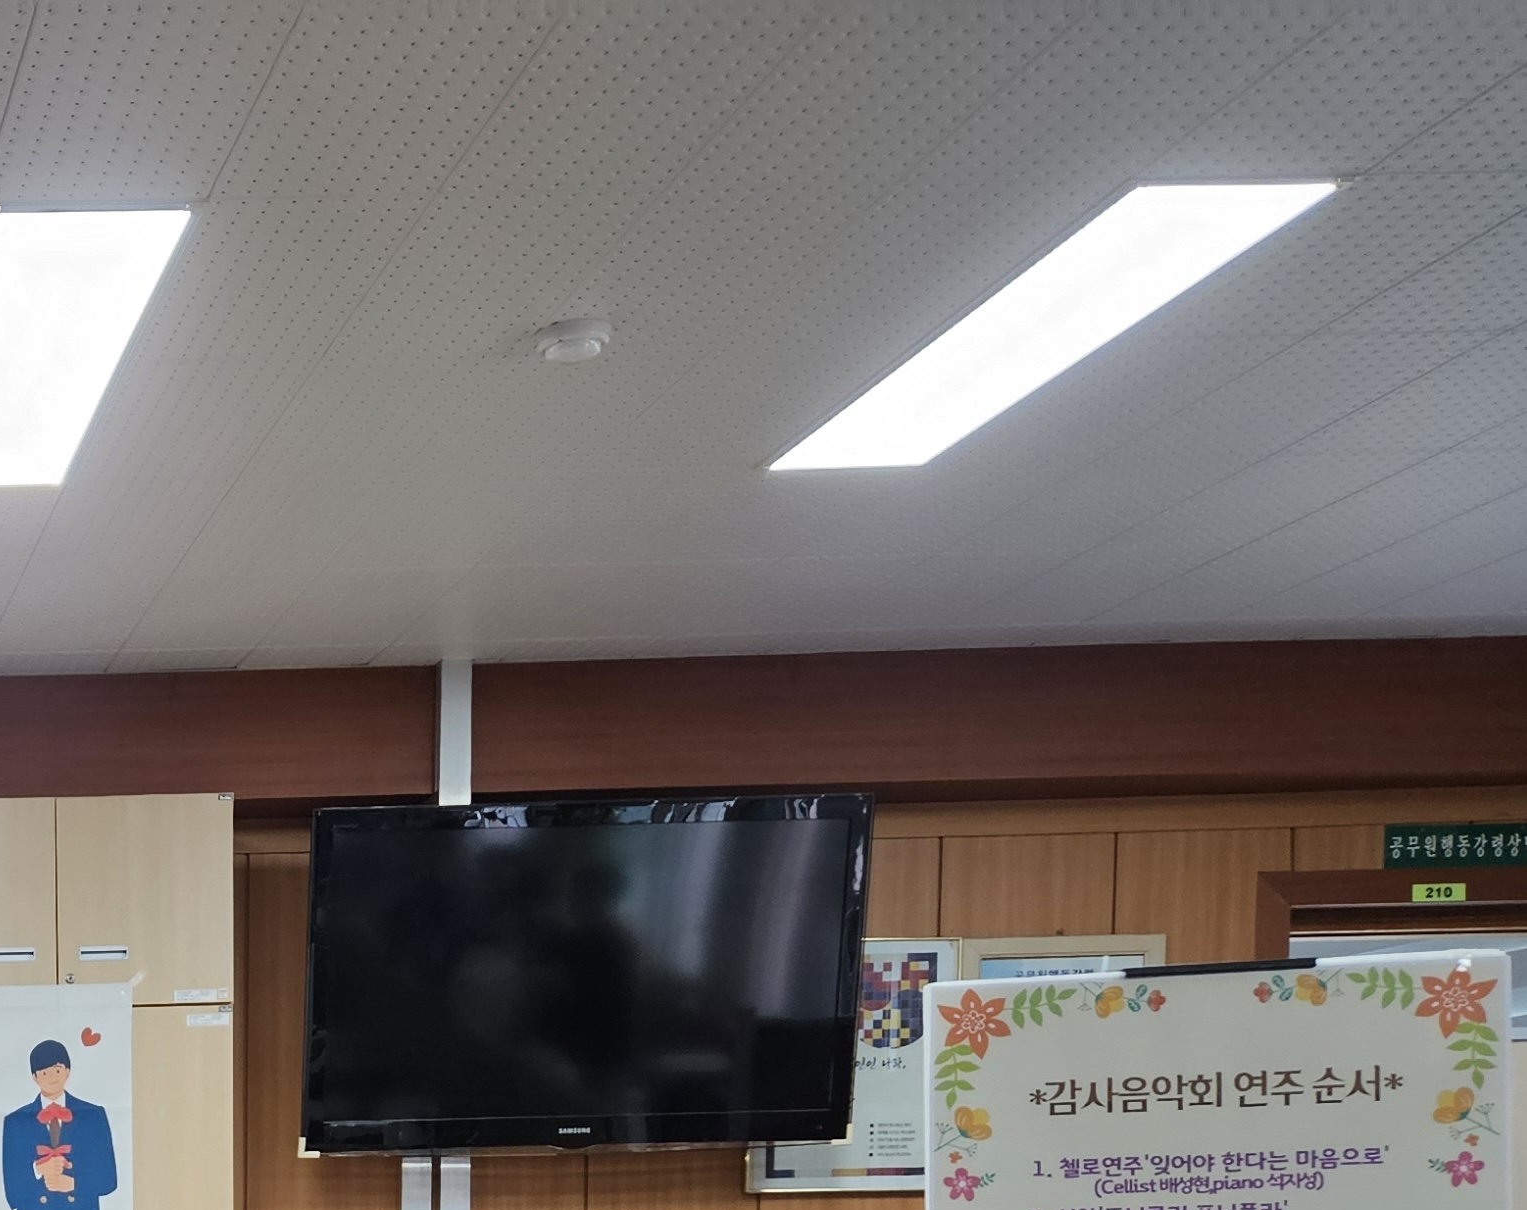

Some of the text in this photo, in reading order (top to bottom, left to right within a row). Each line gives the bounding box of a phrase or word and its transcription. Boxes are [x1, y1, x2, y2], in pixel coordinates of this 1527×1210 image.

[1425, 886, 1453, 899] 210
[1233, 1069, 1304, 1108] 연주
[1033, 1160, 1053, 1178] 1.
[1221, 1150, 1290, 1173] 한다는
[1094, 1178, 1157, 1199] (Cellist
